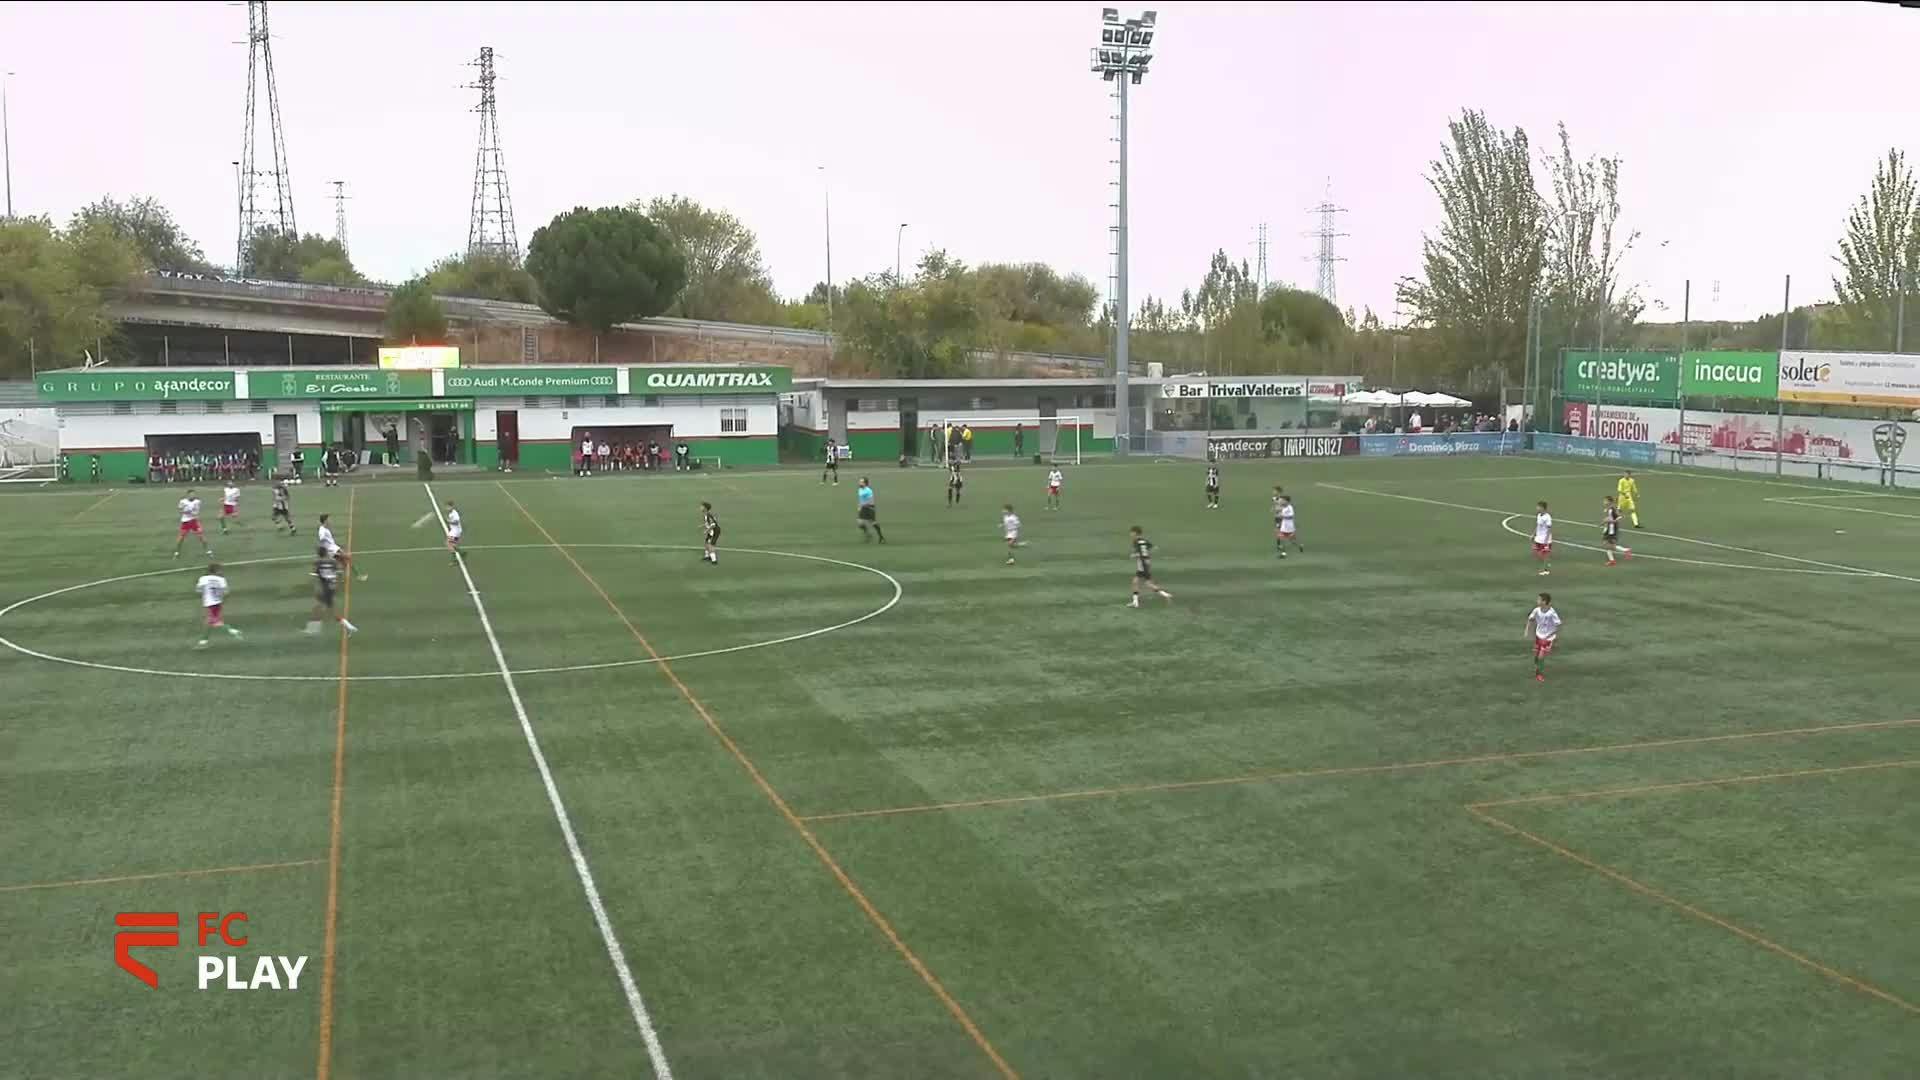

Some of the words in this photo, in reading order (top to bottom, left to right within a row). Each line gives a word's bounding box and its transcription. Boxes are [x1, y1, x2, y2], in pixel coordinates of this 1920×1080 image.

[315, 373, 369, 381] RESTAURANTE
[1695, 358, 1762, 383] inacua
[473, 377, 498, 387] Audi
[500, 377, 544, 386] M.Conde
[545, 376, 590, 386] Premium
[647, 373, 773, 387] QUAMTRAX
[42, 382, 146, 392] GRUPO
[154, 378, 231, 398] afandecor
[1179, 385, 1203, 397] Bar
[1588, 416, 1649, 441] ACORCÓN
[1208, 439, 1268, 459] afandecor
[1455, 441, 1480, 451] Pizza
